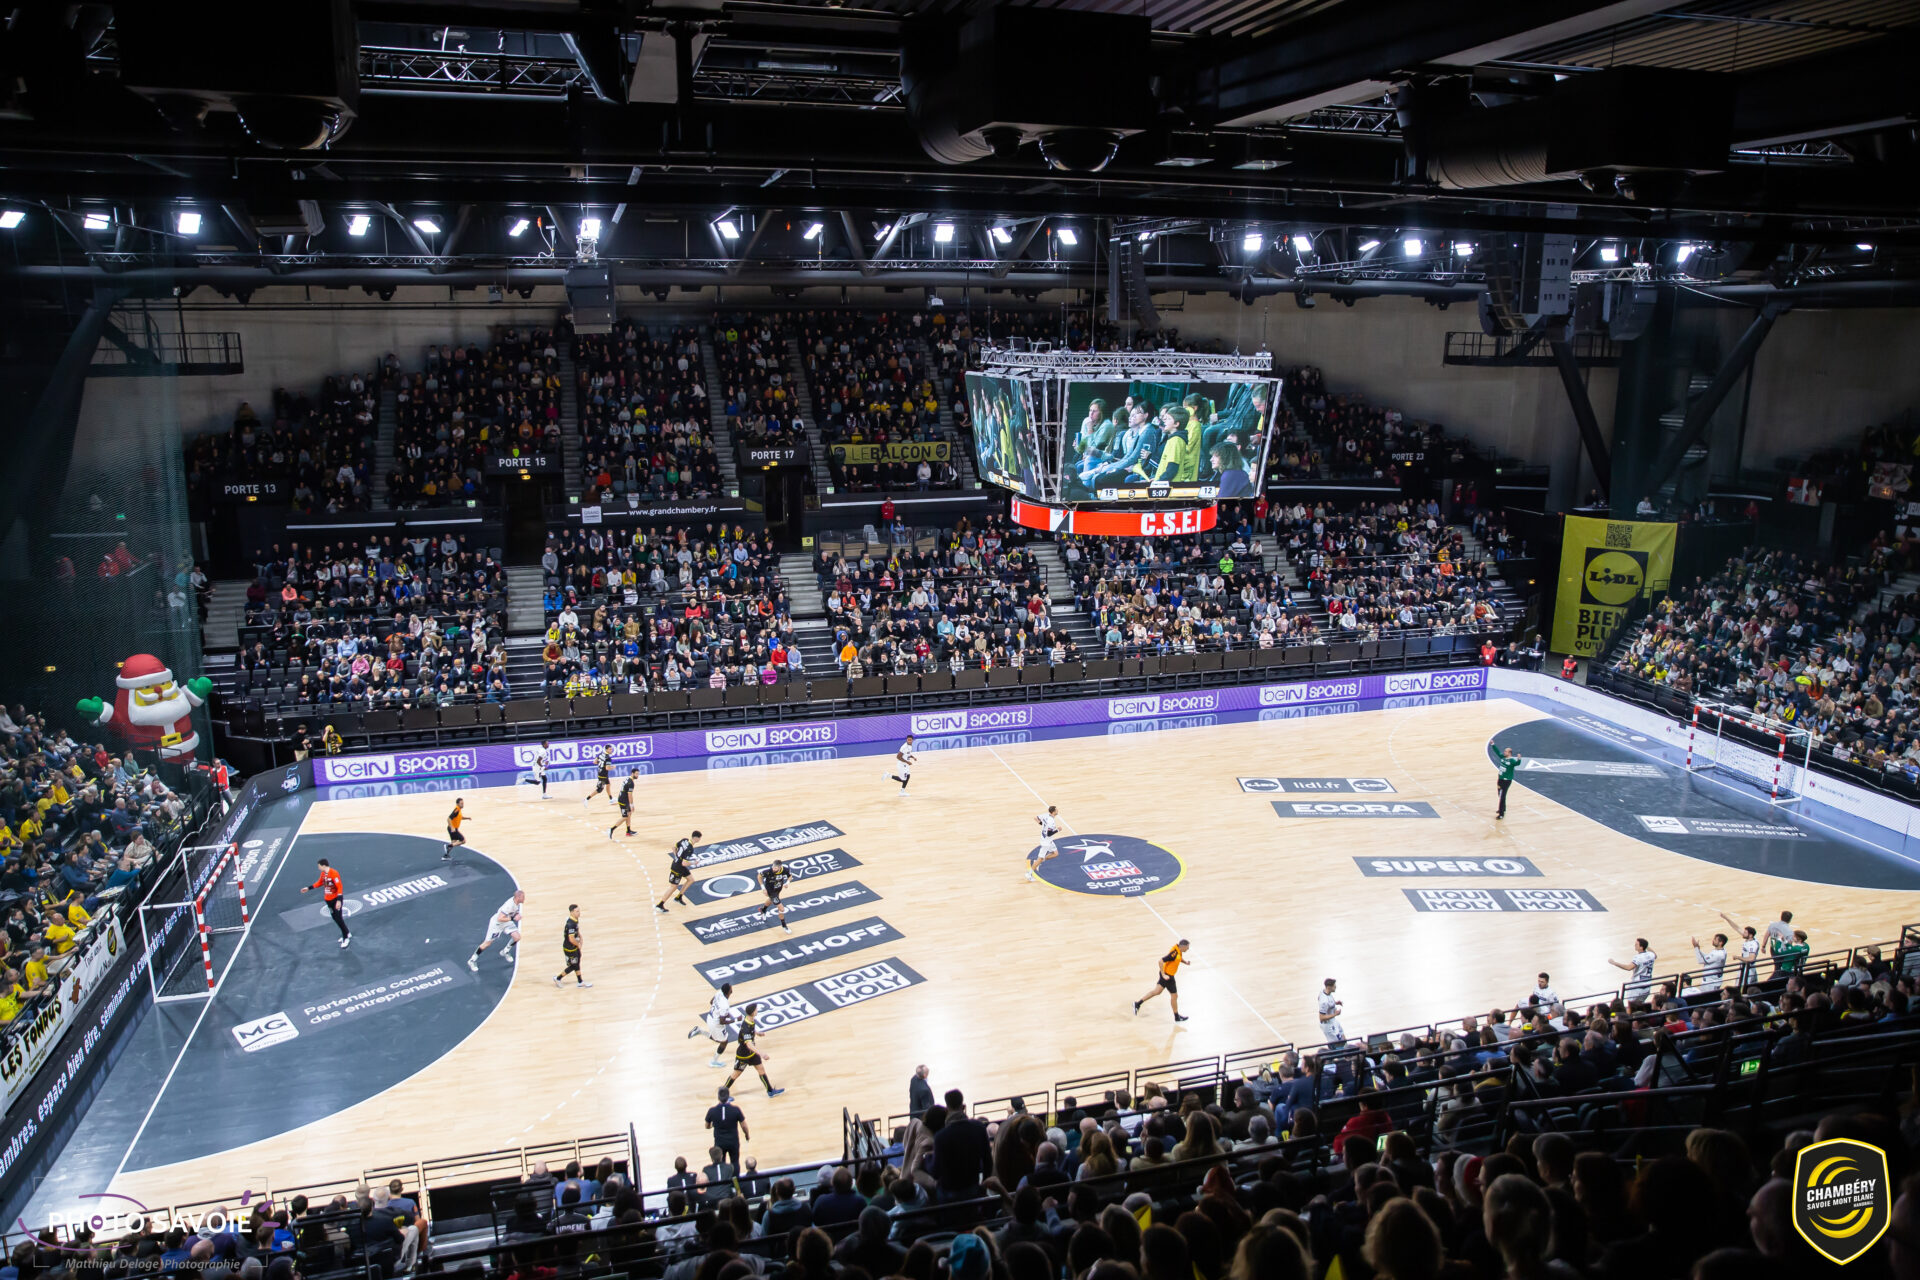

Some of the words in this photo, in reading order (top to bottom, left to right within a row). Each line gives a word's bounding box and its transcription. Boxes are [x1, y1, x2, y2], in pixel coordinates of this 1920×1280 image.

[751, 450, 781, 460] PORTE
[784, 450, 795, 459] 17
[852, 445, 931, 461] LEBALCON
[1392, 452, 1414, 461] PORTE
[498, 458, 531, 467] PORTE
[535, 457, 546, 466] 15
[225, 484, 260, 495] PORTE
[264, 484, 277, 493] 13
[1104, 488, 1114, 497] 15
[1151, 489, 1168, 497] 5:09
[1204, 487, 1213, 495] 12
[628, 505, 718, 517] www.grandchambery.fr
[1432, 672, 1479, 688] SPORTS
[1309, 683, 1357, 698] SPORTS
[1162, 694, 1214, 711] SPORTS
[970, 710, 1028, 727] SPORTS
[769, 726, 832, 743] SPORTS
[398, 754, 470, 774] SPORTS
[1293, 781, 1341, 790] lidl.fr
[1290, 803, 1419, 813] ECORA
[1690, 819, 1753, 829] Partenaire
[1082, 860, 1134, 873] LIQUI
[1091, 867, 1143, 880] MOLY
[1371, 860, 1486, 873] SUPER
[1499, 860, 1520, 872] U
[1086, 874, 1161, 890] StarLigue
[362, 874, 449, 907] SOFINTHER
[1421, 890, 1490, 900] LIQUI
[1506, 890, 1580, 900] LIQUI
[1431, 900, 1495, 910] MOLY
[1520, 900, 1584, 910] MOLY
[819, 963, 893, 992] LIQUI
[303, 986, 387, 1016] Partenaire
[389, 967, 444, 990] conseil
[834, 974, 905, 1004] MOLY
[310, 1009, 341, 1025] des
[345, 975, 453, 1013] entrepreneurs
[38, 1071, 68, 1123] espace
[66, 1046, 85, 1081] bien
[84, 1025, 101, 1055] être,
[100, 976, 131, 1031] séminaire
[129, 964, 138, 985] et
[137, 928, 166, 975] cowrking
[238, 1018, 288, 1040] MG
[0, 1044, 23, 1084] LES
[23, 998, 63, 1054] FONDUS
